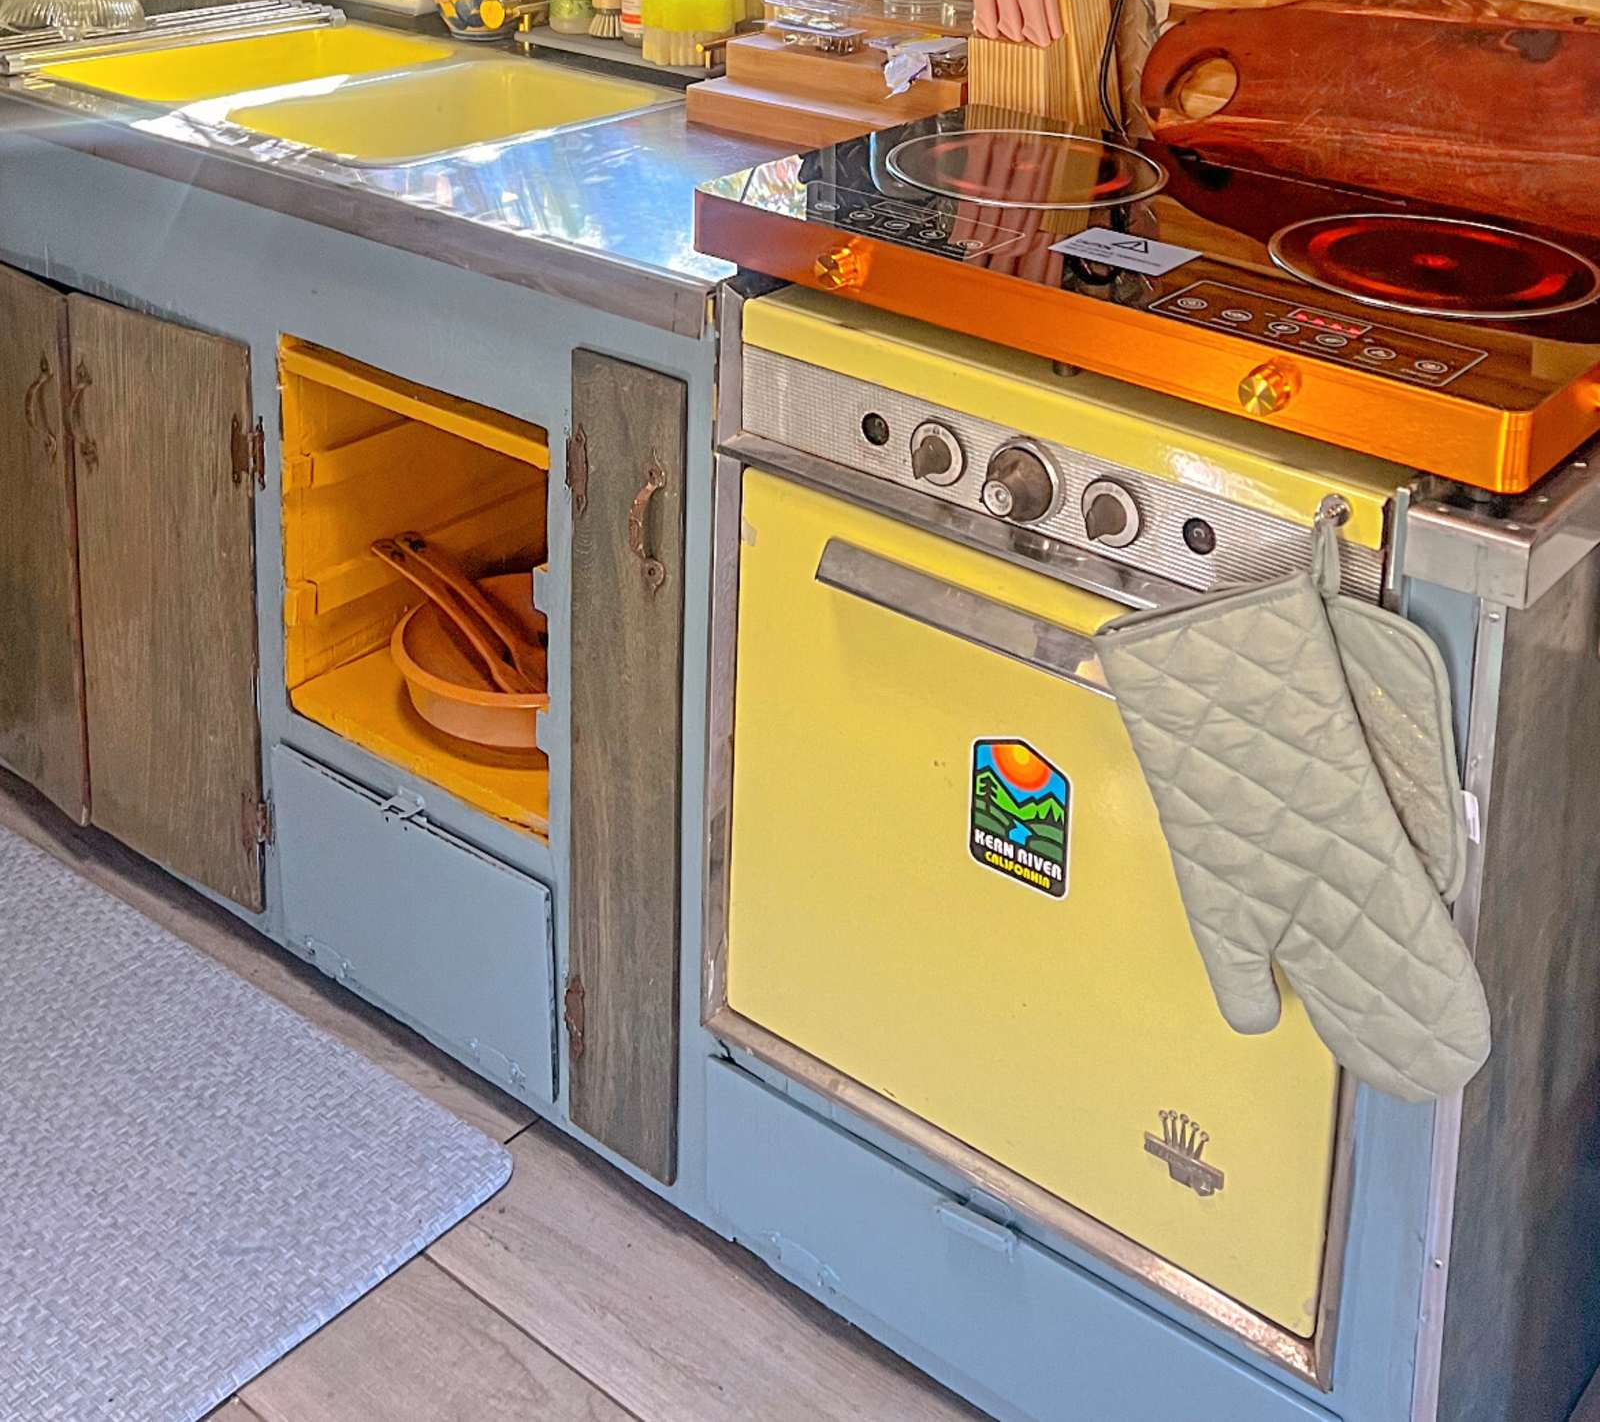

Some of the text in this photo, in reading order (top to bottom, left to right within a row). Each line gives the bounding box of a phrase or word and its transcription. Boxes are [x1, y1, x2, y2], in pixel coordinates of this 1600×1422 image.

[975, 829, 1062, 881] KERN RIVER
[985, 851, 1050, 889] CALIFORNIA
